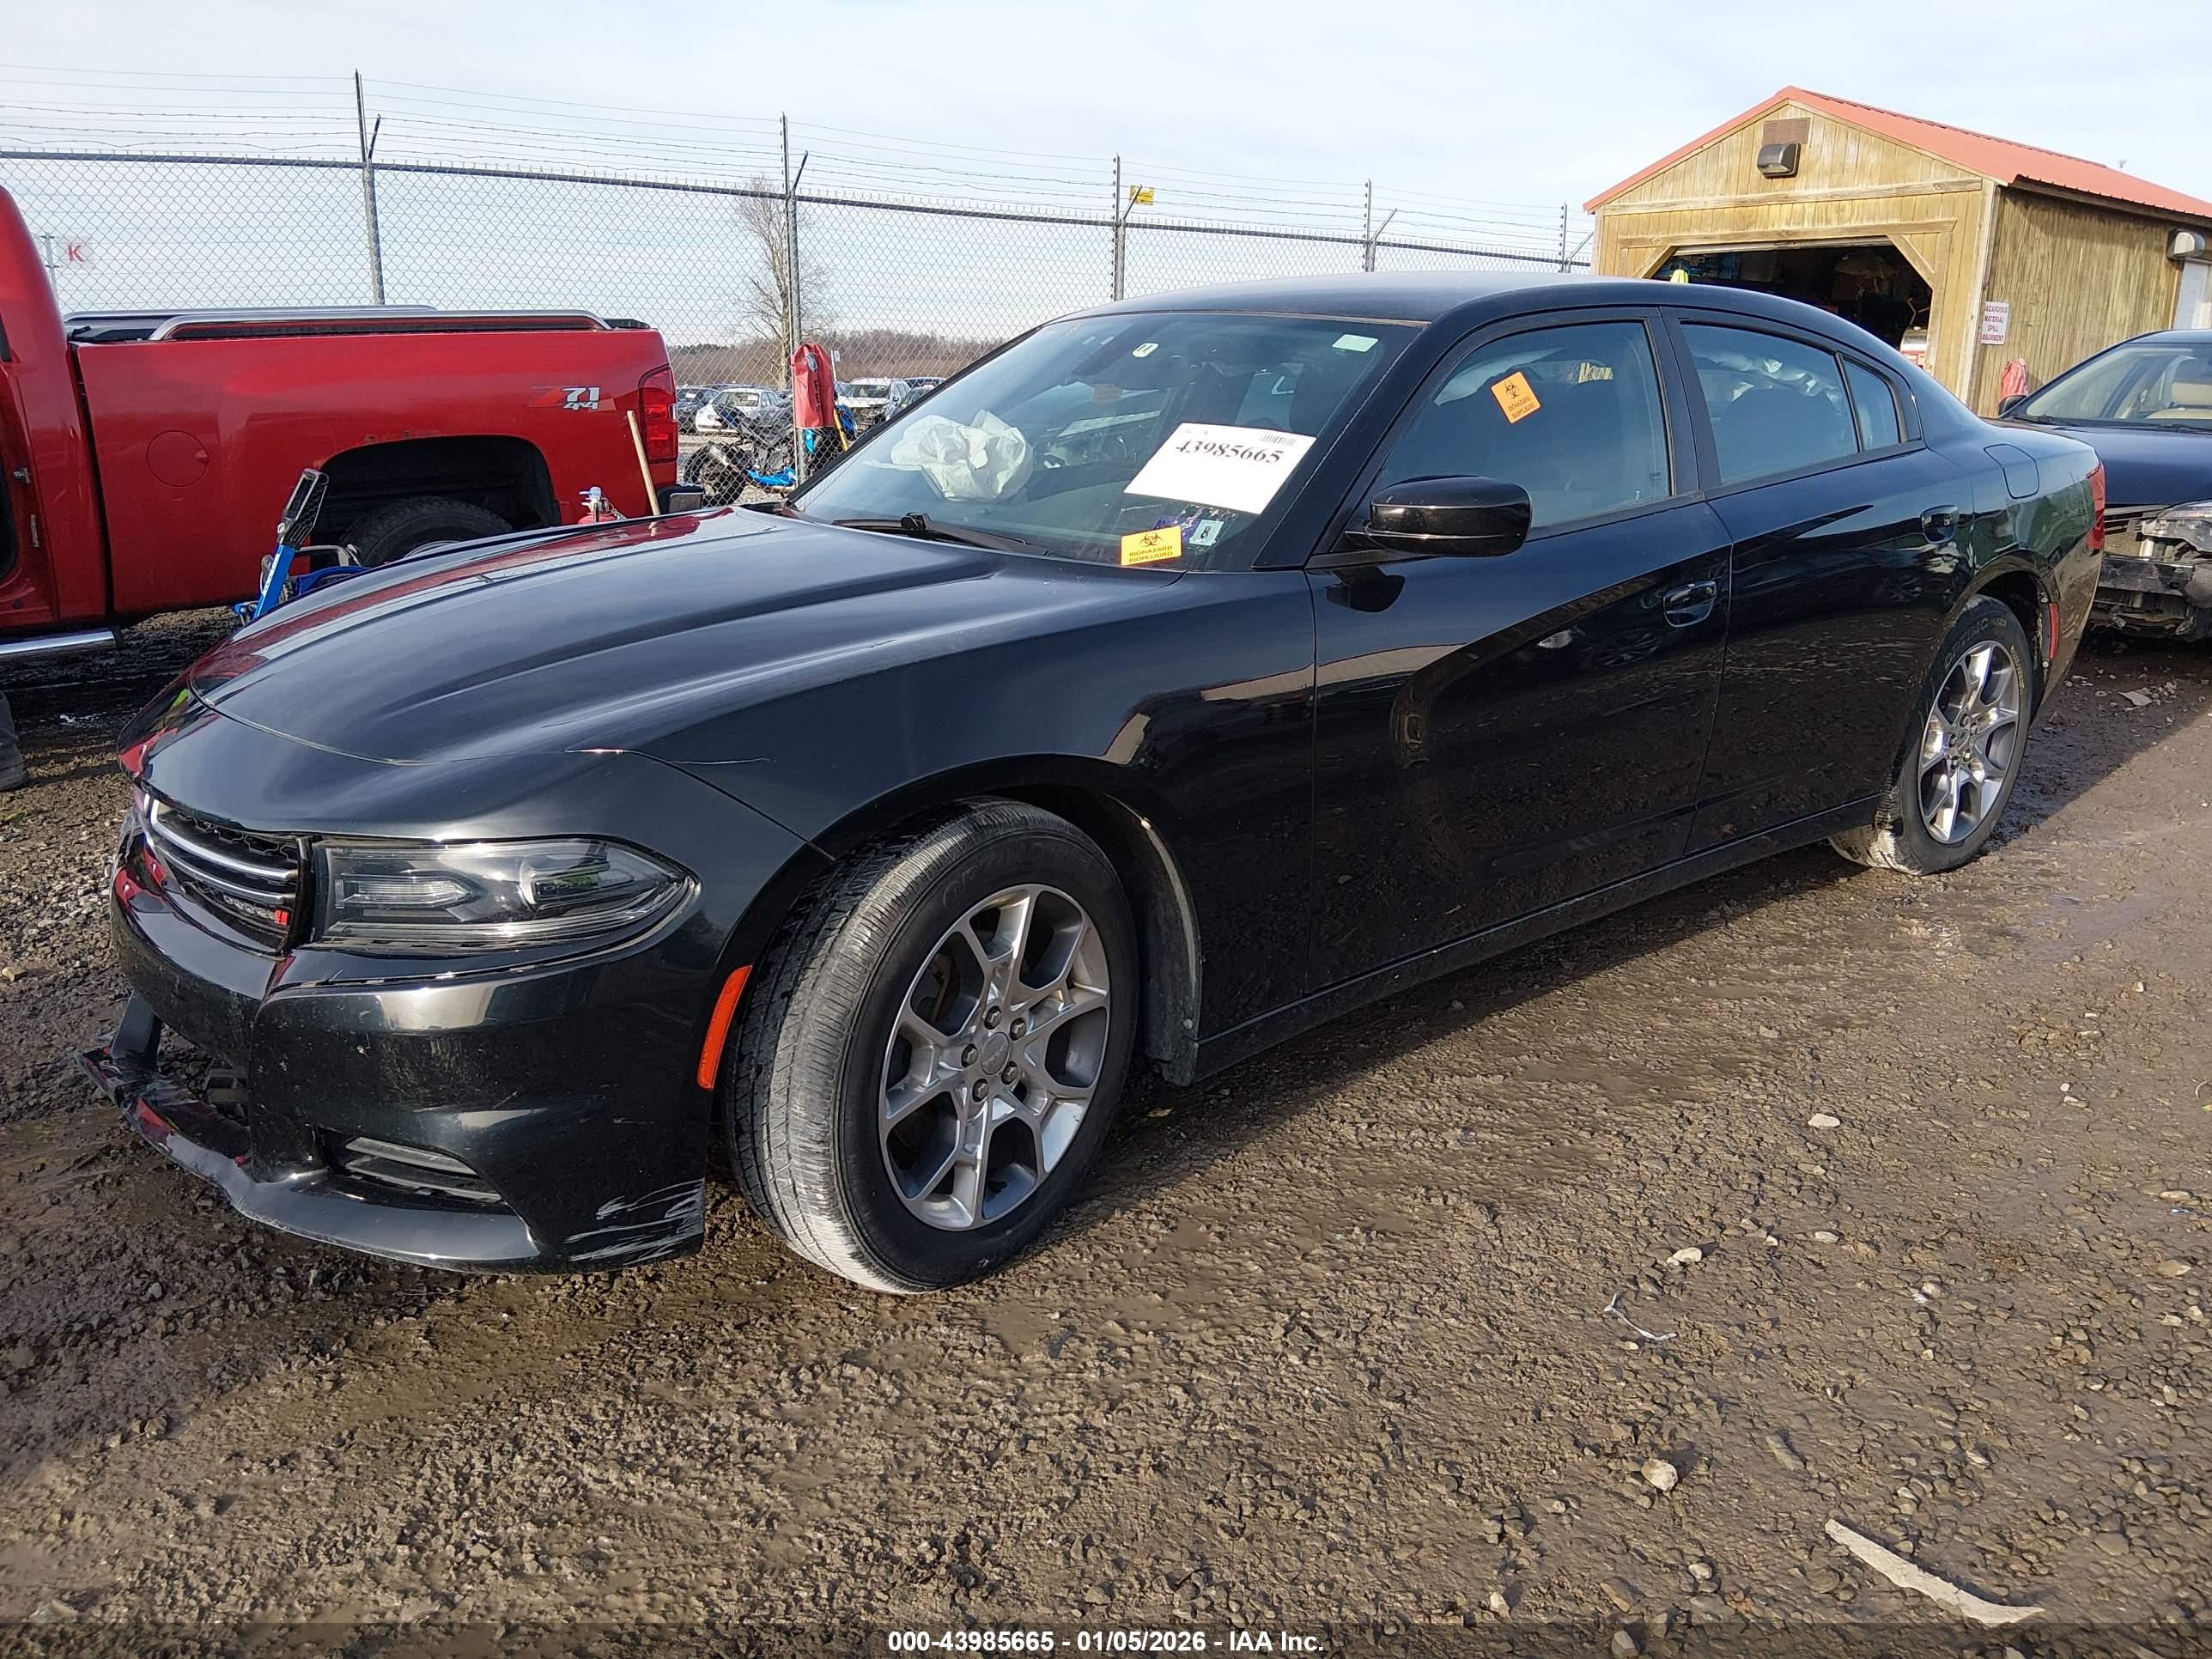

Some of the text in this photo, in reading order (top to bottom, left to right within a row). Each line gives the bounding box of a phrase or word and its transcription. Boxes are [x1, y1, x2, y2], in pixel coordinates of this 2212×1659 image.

[68, 245, 84, 262] K
[1984, 315, 2003, 324] MATERIAL
[1176, 440, 1285, 464] 43985665
[1200, 526, 1212, 539] 8
[1129, 545, 1173, 557] BIOHAZARD
